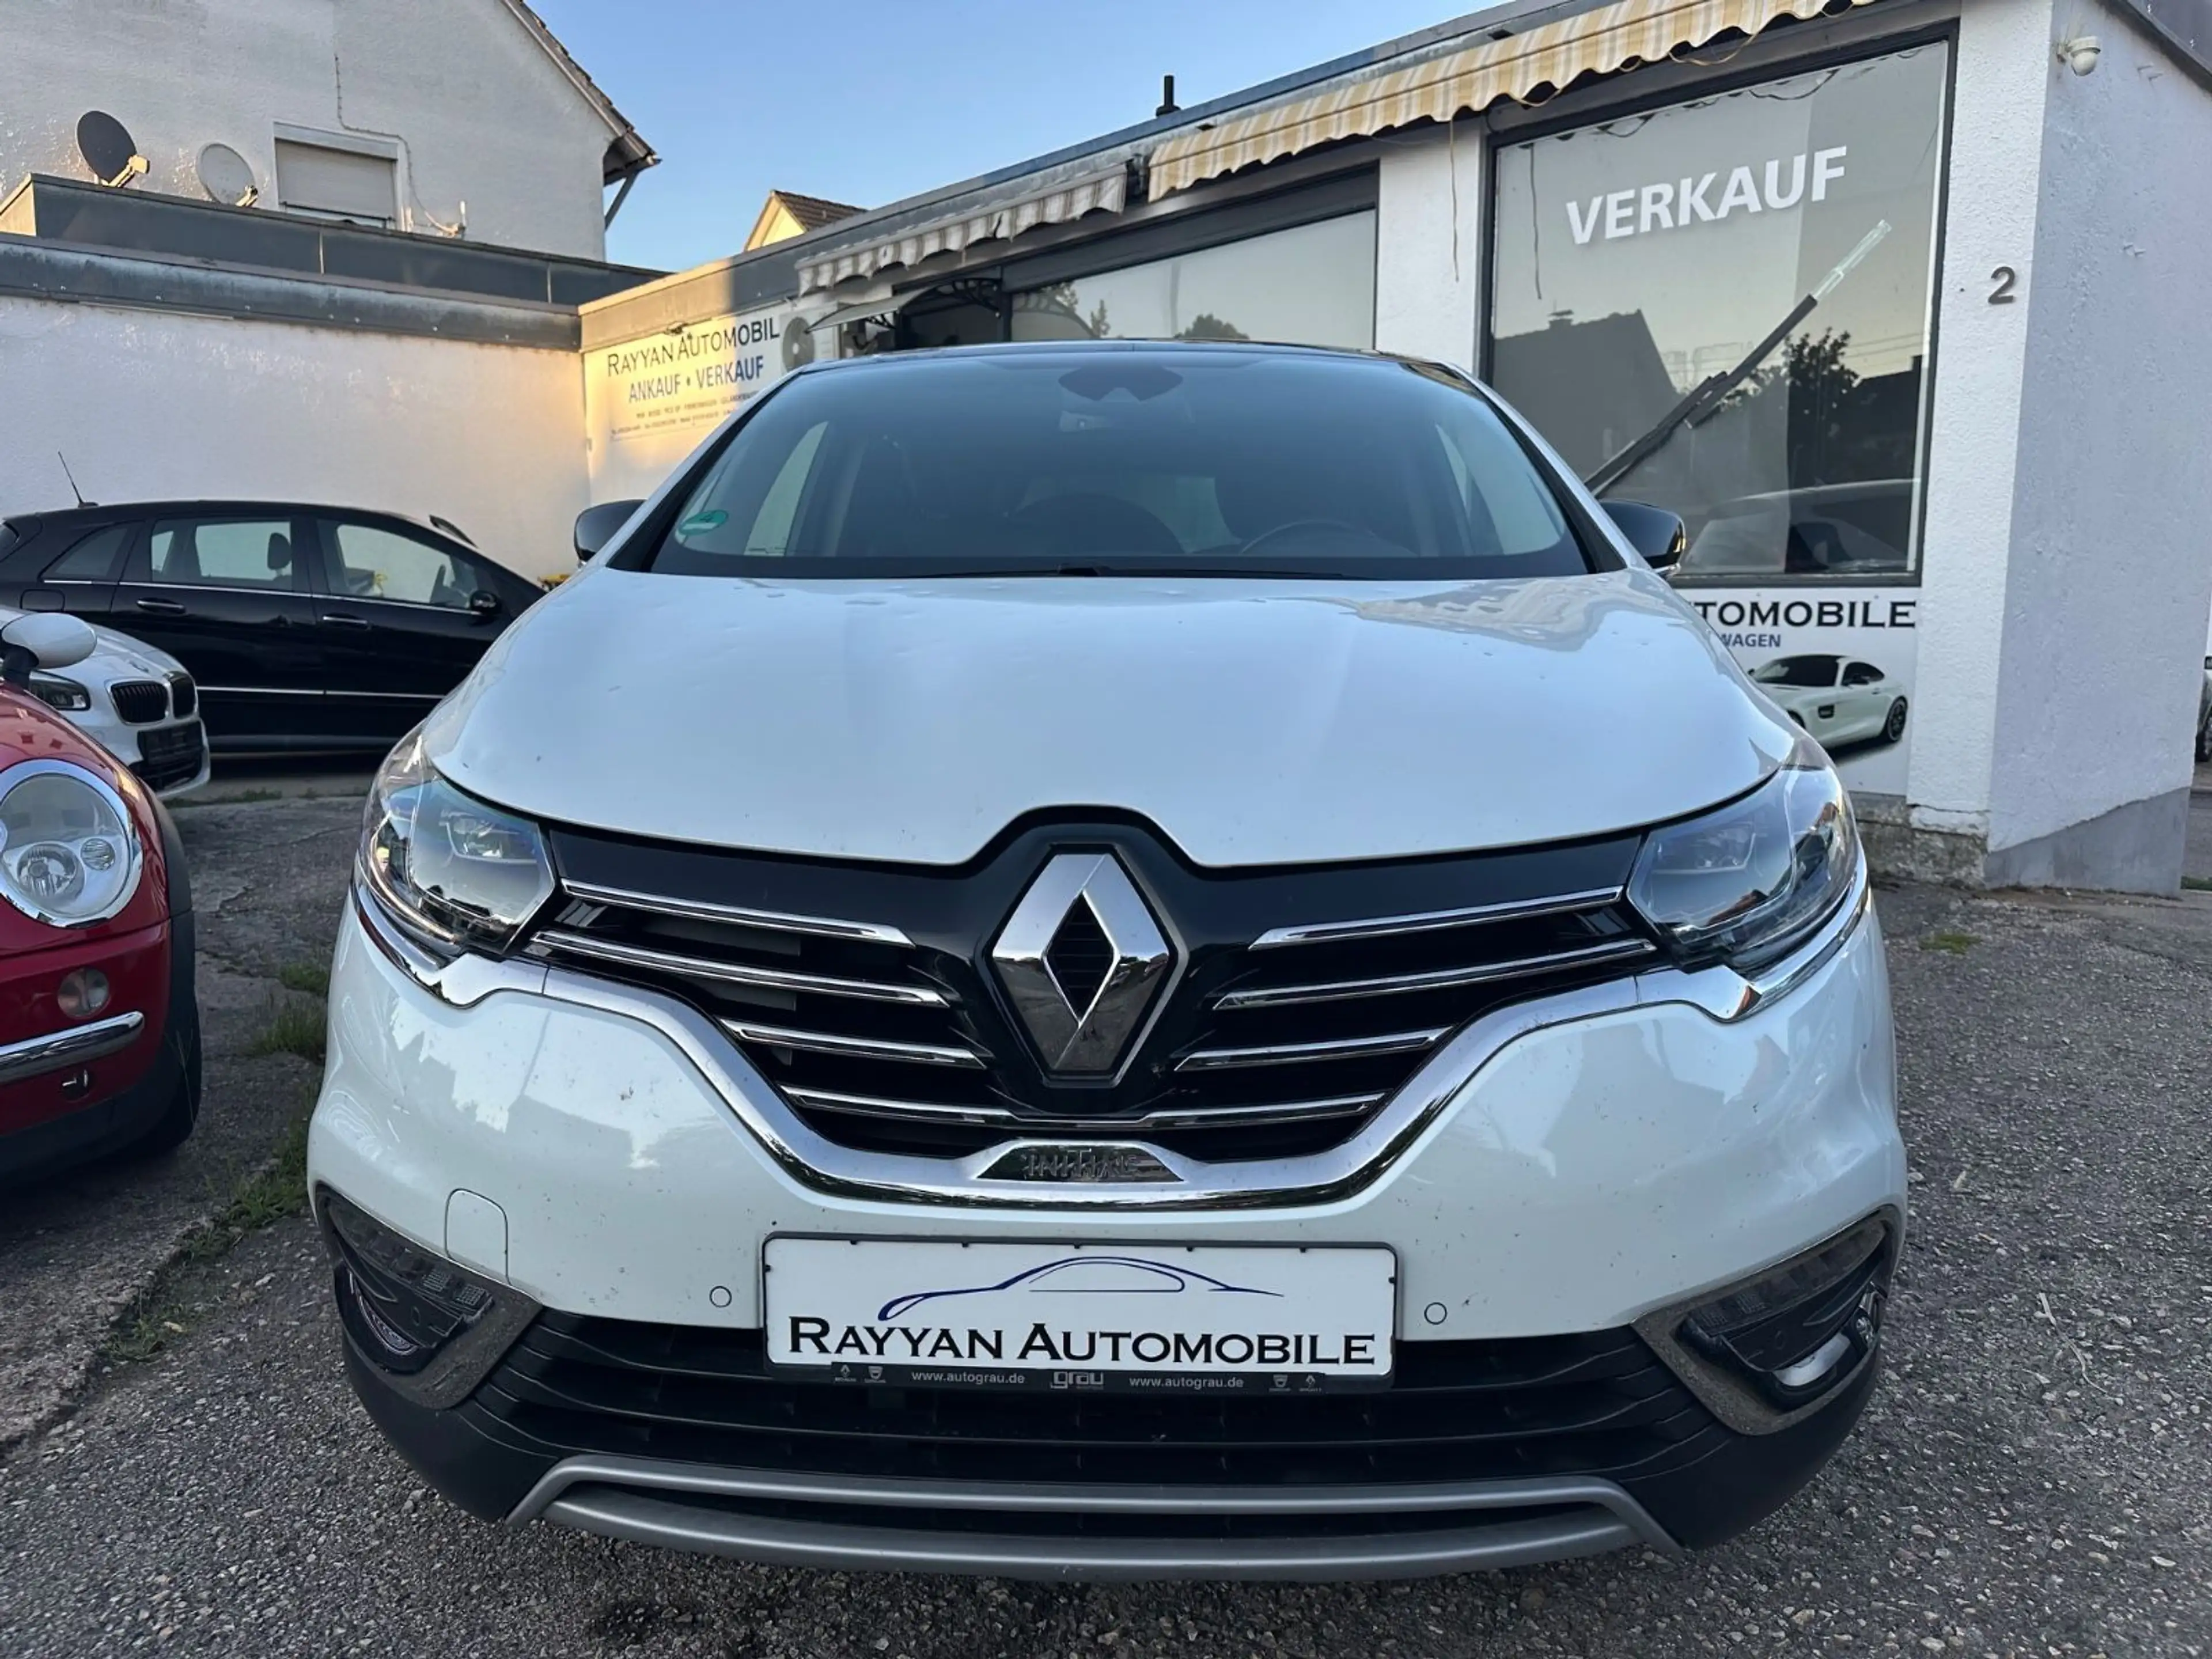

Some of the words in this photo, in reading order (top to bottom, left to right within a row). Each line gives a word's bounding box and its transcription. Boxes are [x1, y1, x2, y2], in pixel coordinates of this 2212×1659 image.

[1566, 146, 1847, 245] VERKAUF
[1987, 266, 2017, 305] 2
[608, 342, 673, 376] RAYYAN
[629, 374, 681, 403] ANKAUF
[695, 355, 764, 389] VERKAUF
[1688, 600, 1916, 628] TOMOBILE
[789, 1315, 1003, 1359] RAYYAN
[1017, 1323, 1375, 1365] AUTOMOBILE
[911, 1371, 1025, 1384] www.autograu.de
[1050, 1371, 1104, 1389] grau
[1128, 1376, 1244, 1390] www.autograu.de
